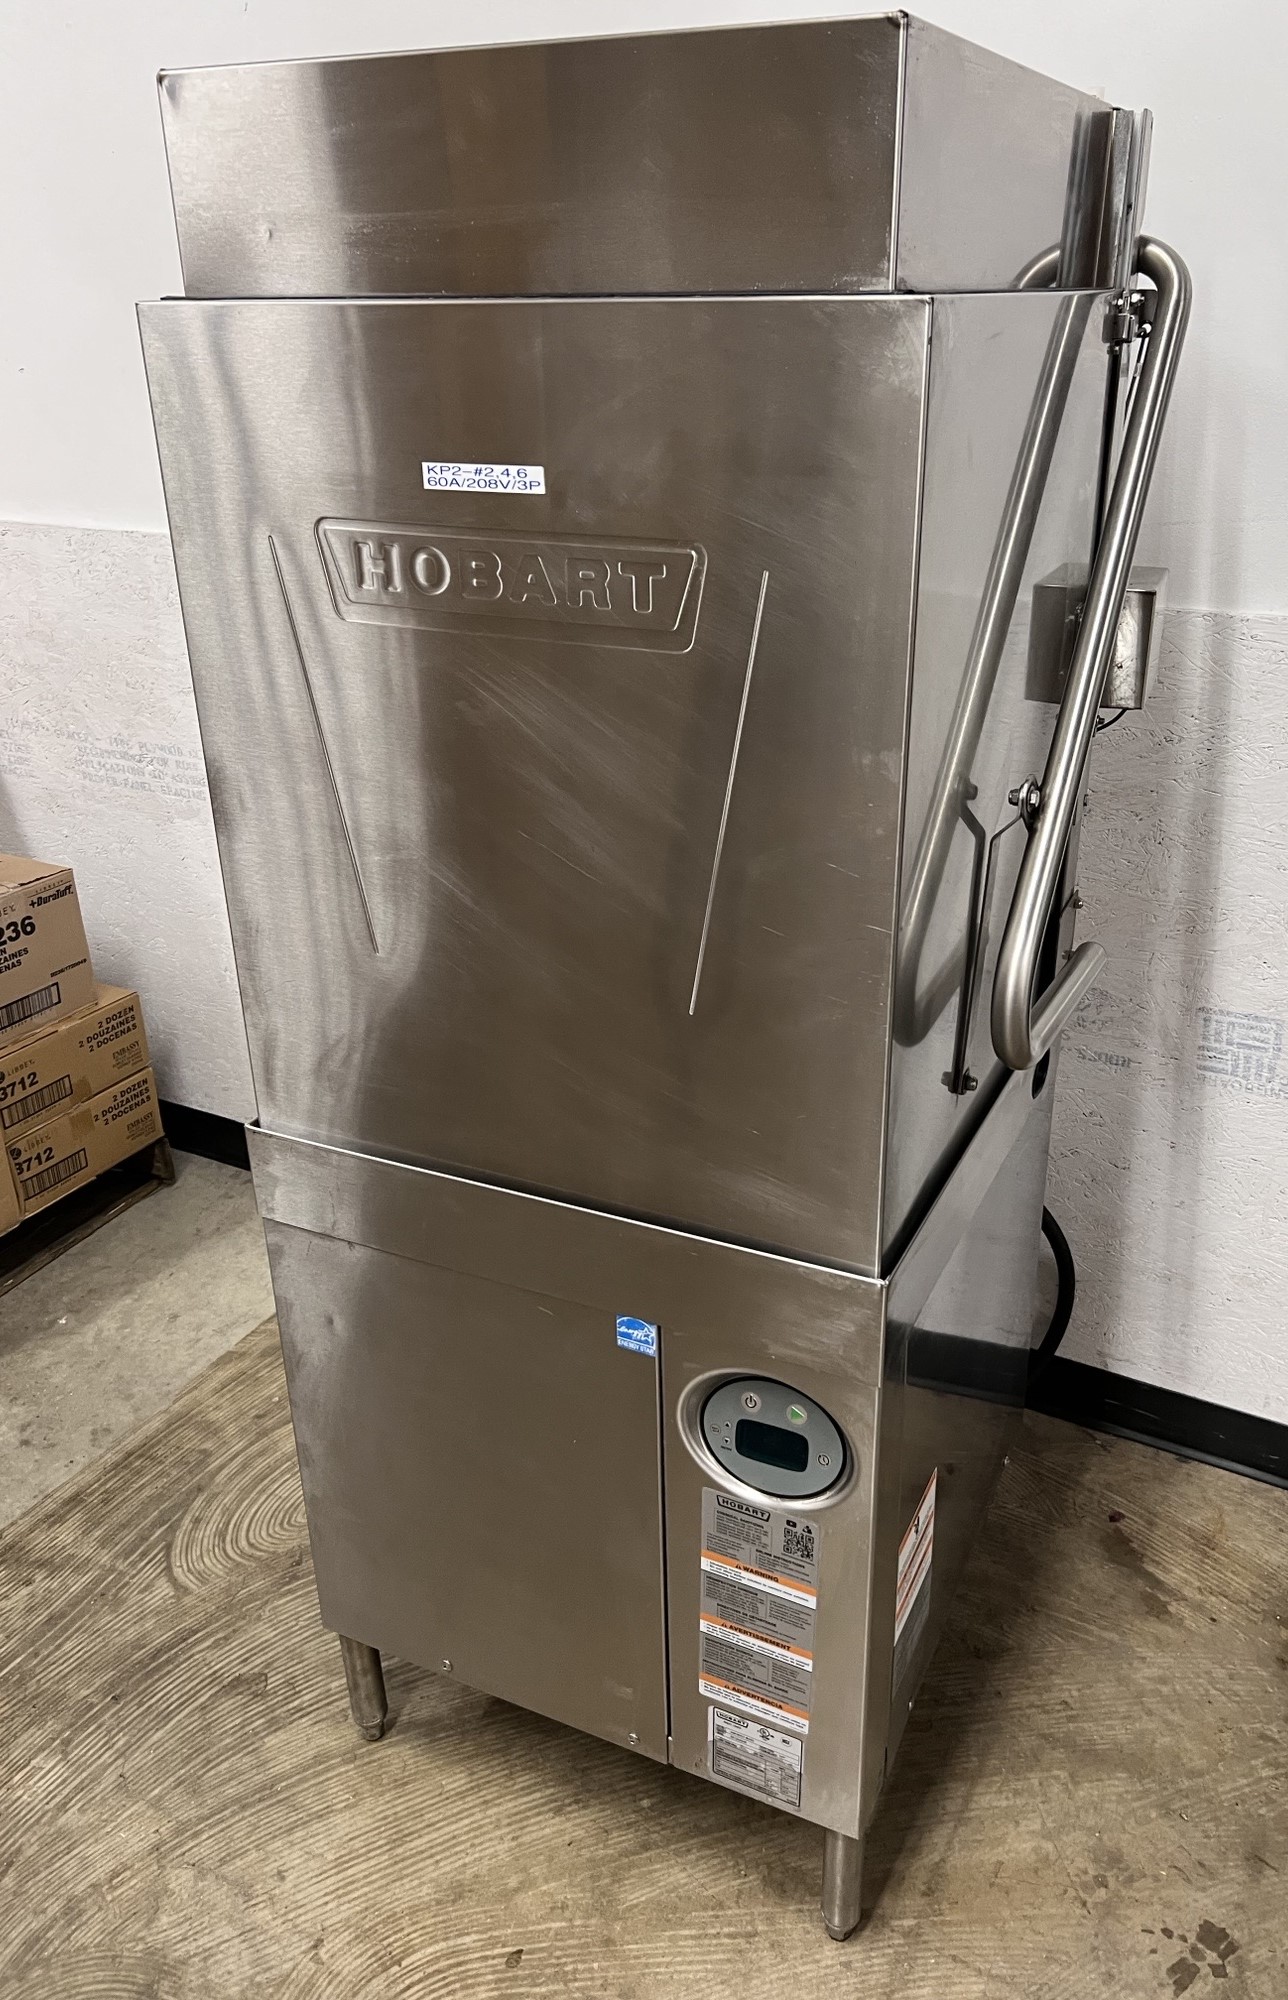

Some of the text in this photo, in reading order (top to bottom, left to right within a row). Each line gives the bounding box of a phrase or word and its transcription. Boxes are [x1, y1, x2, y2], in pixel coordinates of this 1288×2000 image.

[427, 464, 528, 479] KP2-#2,4,6
[427, 476, 541, 492] 60A/208V/3P
[354, 540, 667, 613] HOBART
[0, 904, 16, 917] EY
[98, 1004, 134, 1029] 2 DOZEN
[78, 1014, 136, 1048] 2 DOUZAINES
[88, 1023, 137, 1053] 2 DOCENAS
[120, 1078, 148, 1098] DOZEN
[93, 1086, 150, 1122] 2 DOUZAINES
[103, 1094, 151, 1126] 2 DOCENAS
[722, 1499, 766, 1518] HOBART
[743, 1565, 779, 1583] WARNING
[729, 1625, 791, 1651] AVERTISSEMENT
[732, 1686, 783, 1709] ADVERTENCIA
